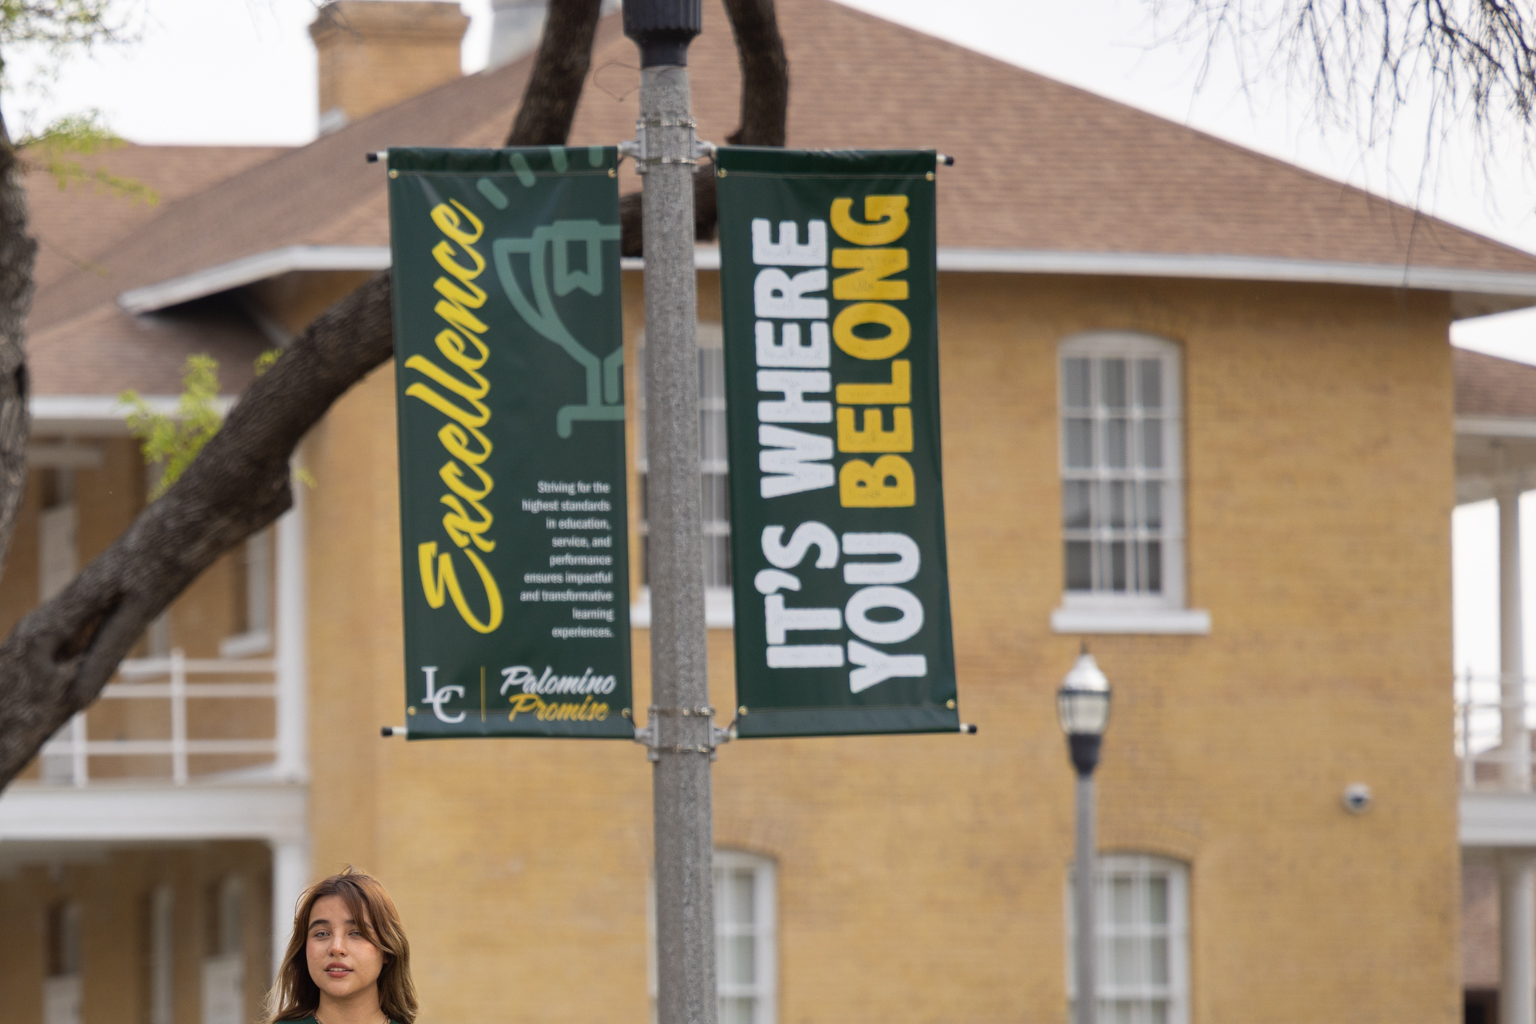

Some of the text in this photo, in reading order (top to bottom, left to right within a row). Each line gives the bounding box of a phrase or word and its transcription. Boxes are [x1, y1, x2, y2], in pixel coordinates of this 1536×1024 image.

[404, 197, 504, 634] Excellence
[752, 218, 844, 668] IT'S WHERE
[829, 194, 927, 693] YOU BELONG
[537, 480, 610, 495] Striving for the
[521, 499, 610, 514] highest standards
[546, 517, 611, 531] in education,
[552, 535, 611, 549] service, and
[549, 554, 612, 567] performance
[524, 571, 612, 586] ensures impactful
[520, 590, 613, 602] and transformative
[572, 608, 614, 622] learning
[552, 626, 614, 640] experiences.
[500, 665, 616, 695] Palomino
[508, 694, 610, 721] Promise
